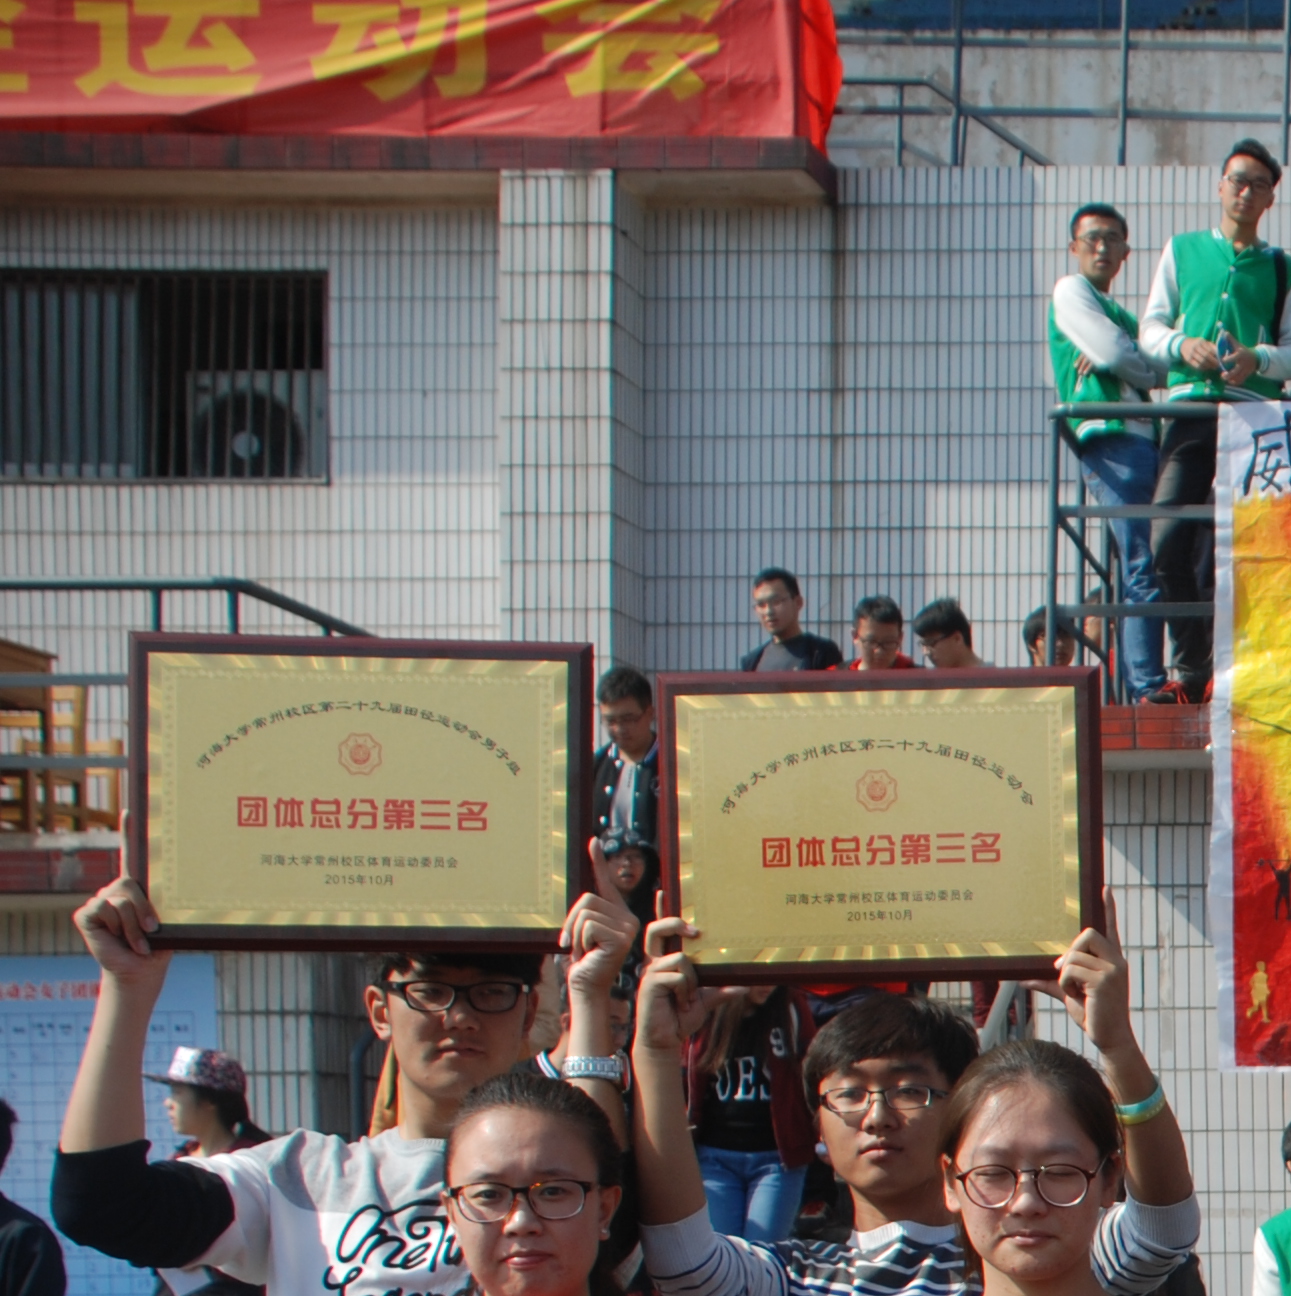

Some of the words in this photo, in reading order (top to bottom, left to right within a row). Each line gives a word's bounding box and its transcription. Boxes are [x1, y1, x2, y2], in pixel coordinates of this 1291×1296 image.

[0, 0, 722, 102] 运动会
[237, 796, 489, 831] 团体总分第三名
[762, 832, 1001, 868] 团体总分第三名
[260, 853, 458, 869] 河海大学常州校区体育运动委员会
[325, 873, 394, 886] 2015年10月
[785, 889, 974, 905] 河海大学常州校区体育运动委员会
[847, 910, 912, 921] 2015年10月
